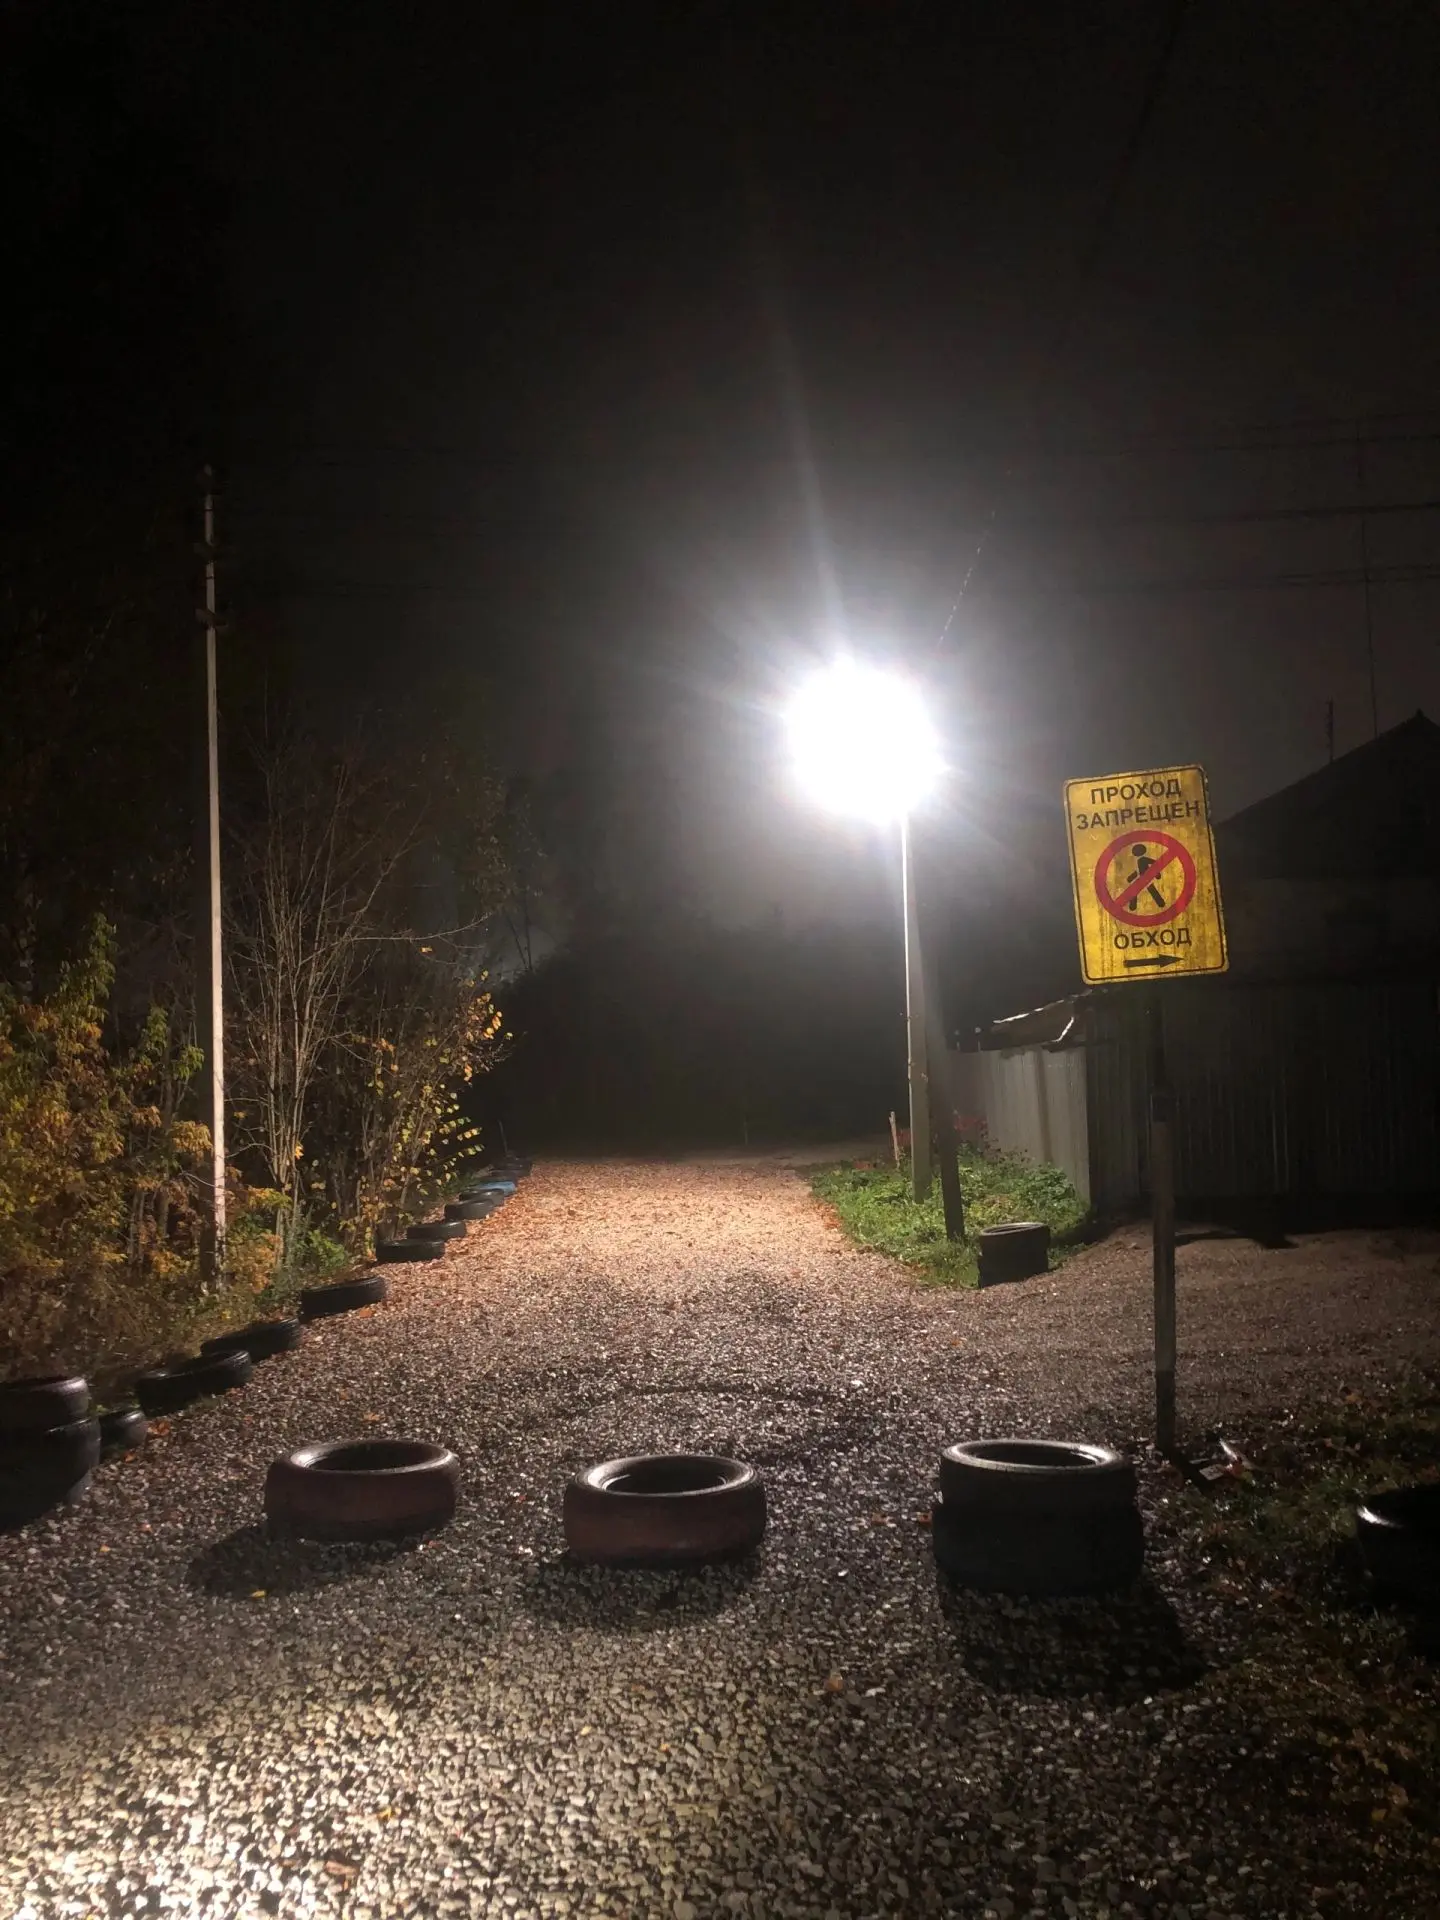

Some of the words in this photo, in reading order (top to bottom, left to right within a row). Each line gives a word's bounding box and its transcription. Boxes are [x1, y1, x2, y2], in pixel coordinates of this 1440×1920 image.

[1090, 778, 1182, 805] ПРОХОД
[1077, 800, 1201, 830] ЗАПРЕЩЕН
[1114, 927, 1192, 950] ОБХОД
